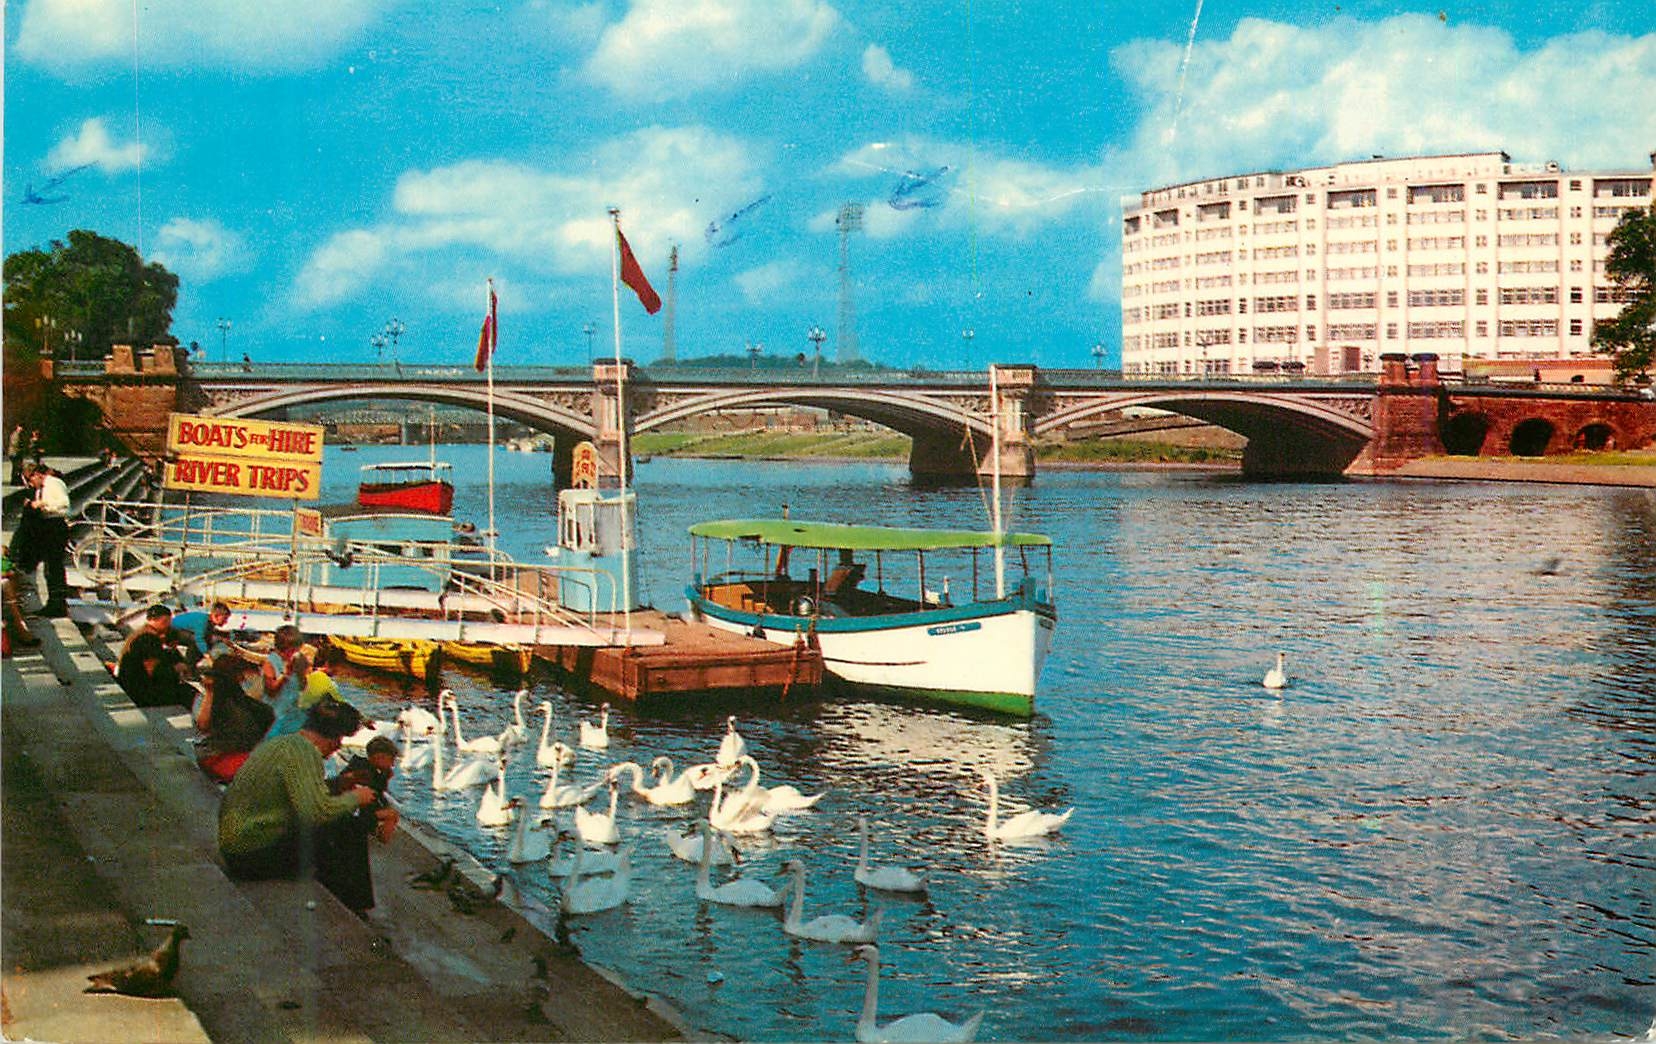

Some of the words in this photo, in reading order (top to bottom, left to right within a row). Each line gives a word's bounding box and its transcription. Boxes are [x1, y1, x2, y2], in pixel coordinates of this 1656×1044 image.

[178, 421, 248, 449] BOATS
[249, 432, 269, 445] FOR
[267, 428, 317, 455] HIRE
[174, 459, 241, 487] RIVER
[247, 464, 311, 493] TRIPS
